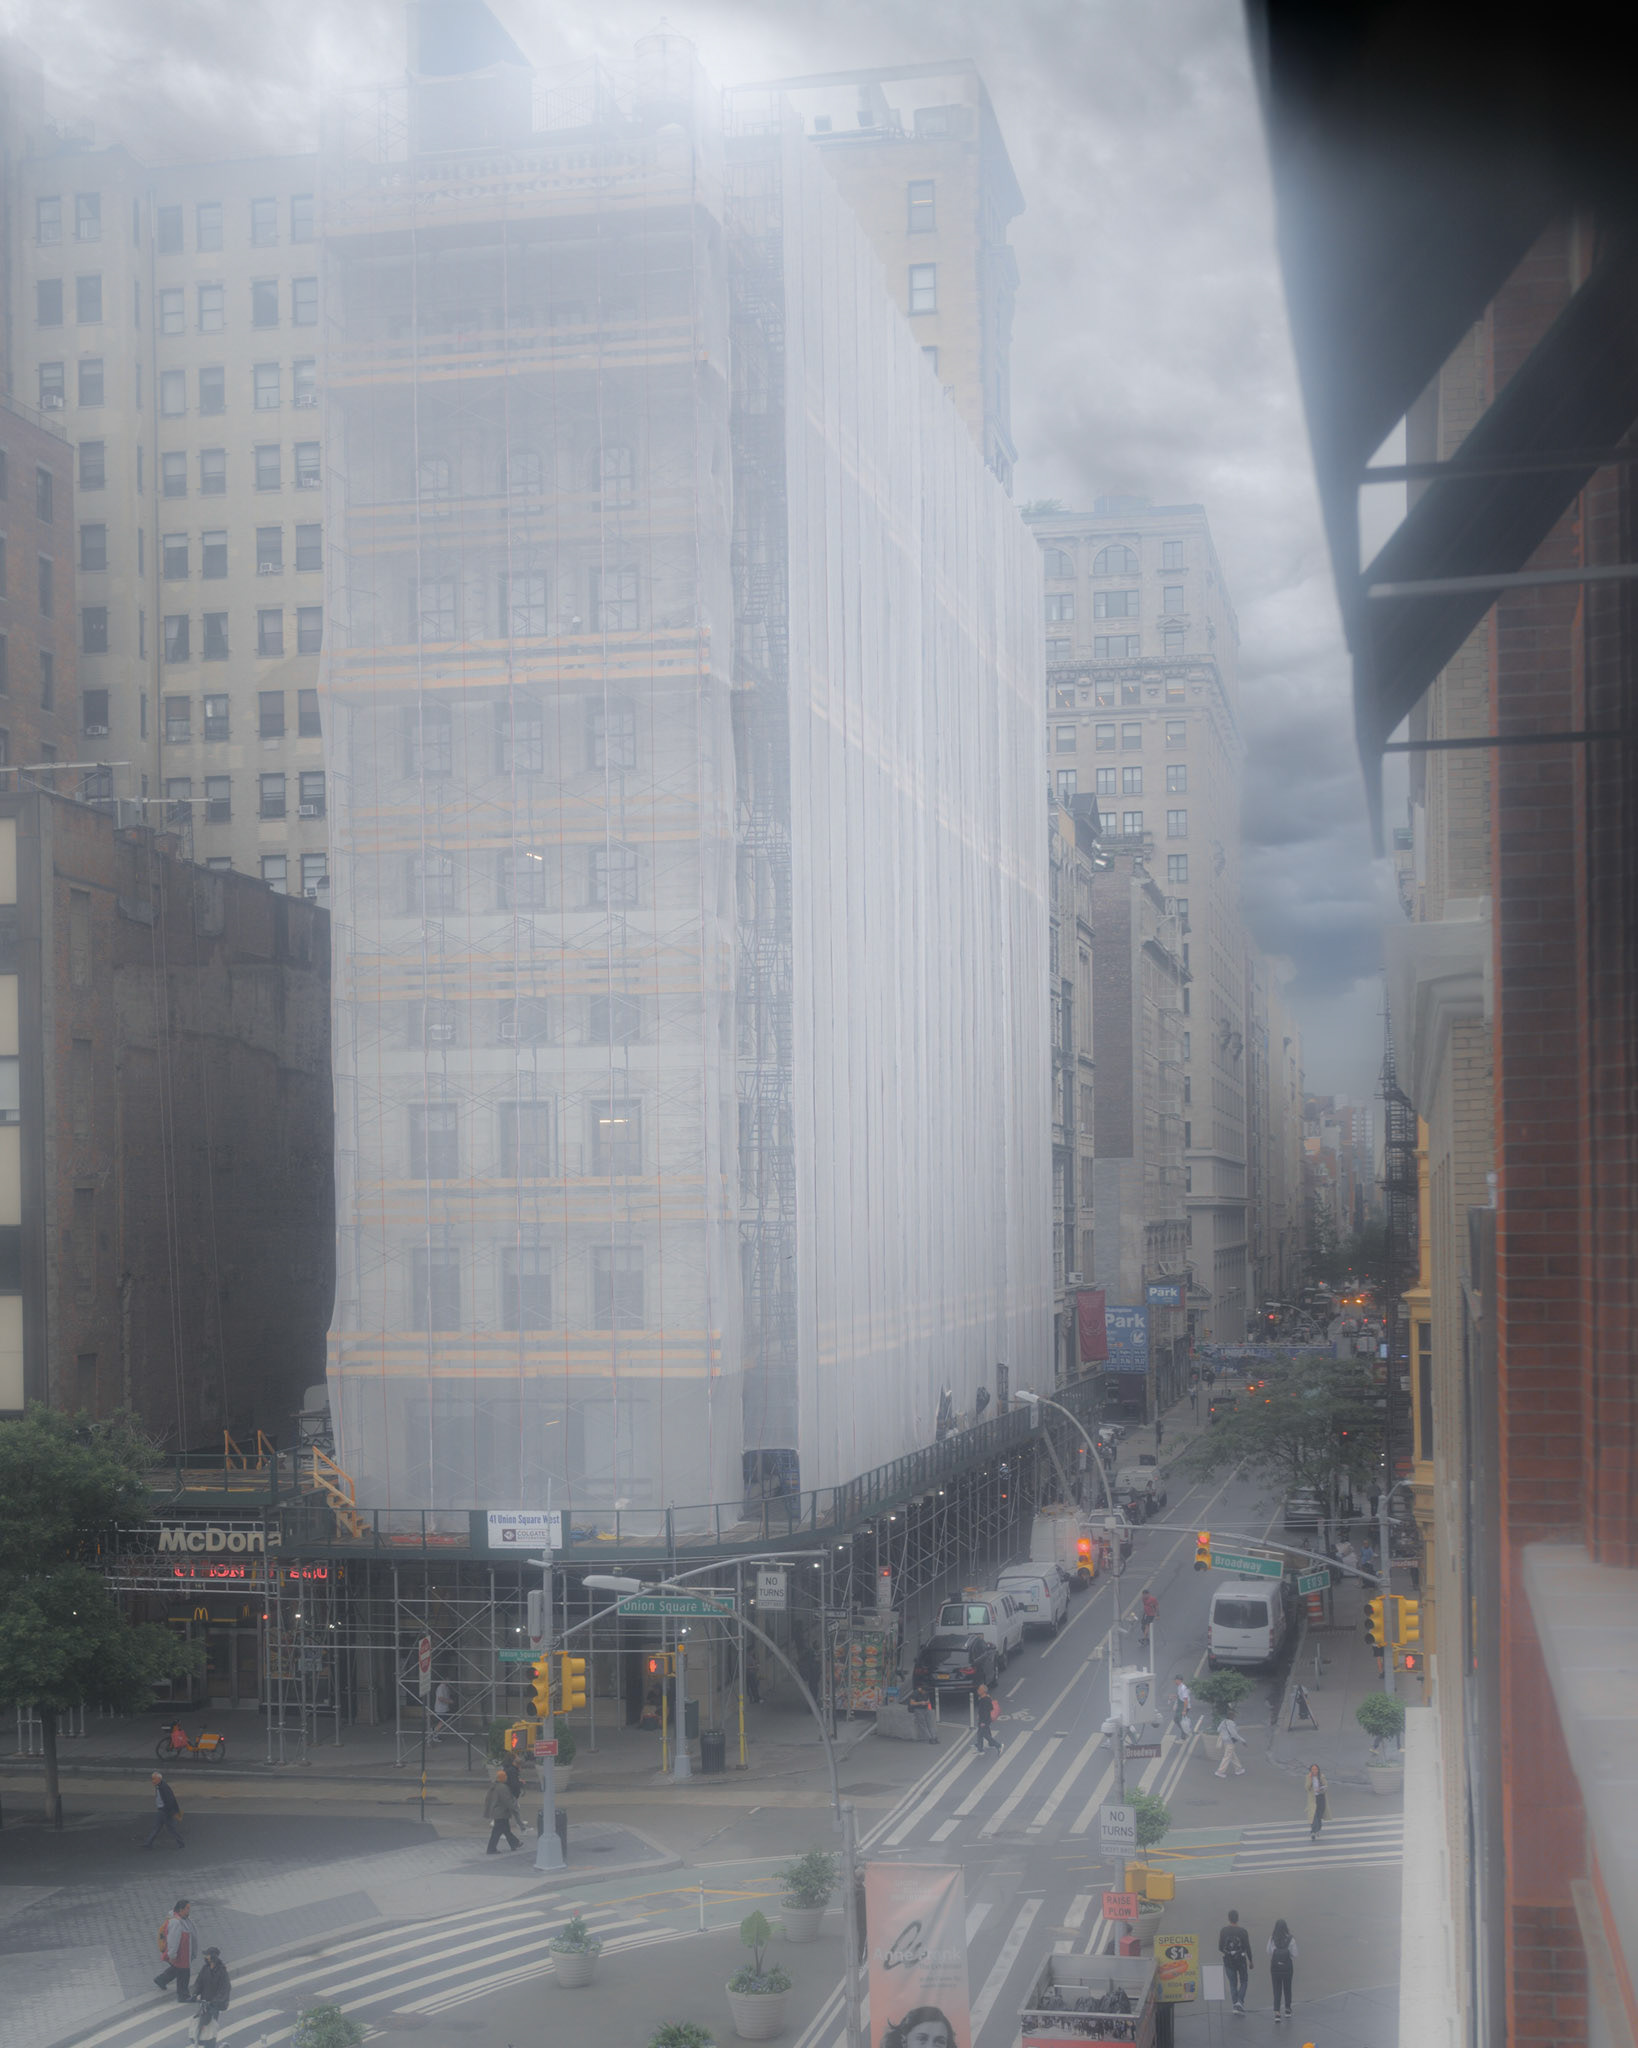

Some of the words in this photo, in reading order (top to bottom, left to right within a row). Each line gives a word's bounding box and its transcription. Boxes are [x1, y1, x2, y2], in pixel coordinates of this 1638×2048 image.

[1149, 1287, 1178, 1297] Park
[1105, 1313, 1145, 1328] Park
[498, 1514, 517, 1524] Union
[518, 1514, 541, 1526] Square
[1214, 1555, 1262, 1573] Broadway
[765, 1577, 778, 1585] NO
[760, 1588, 784, 1597] TURNS
[624, 1601, 655, 1611] Union
[660, 1601, 697, 1613] Square
[1110, 1811, 1125, 1822] NO
[1102, 1825, 1134, 1837] TURNS
[1106, 1895, 1131, 1904] RAISE
[1109, 1907, 1131, 1916] PLOW
[1158, 1936, 1195, 1944] SPECIAL
[873, 1947, 914, 1961] Anne
